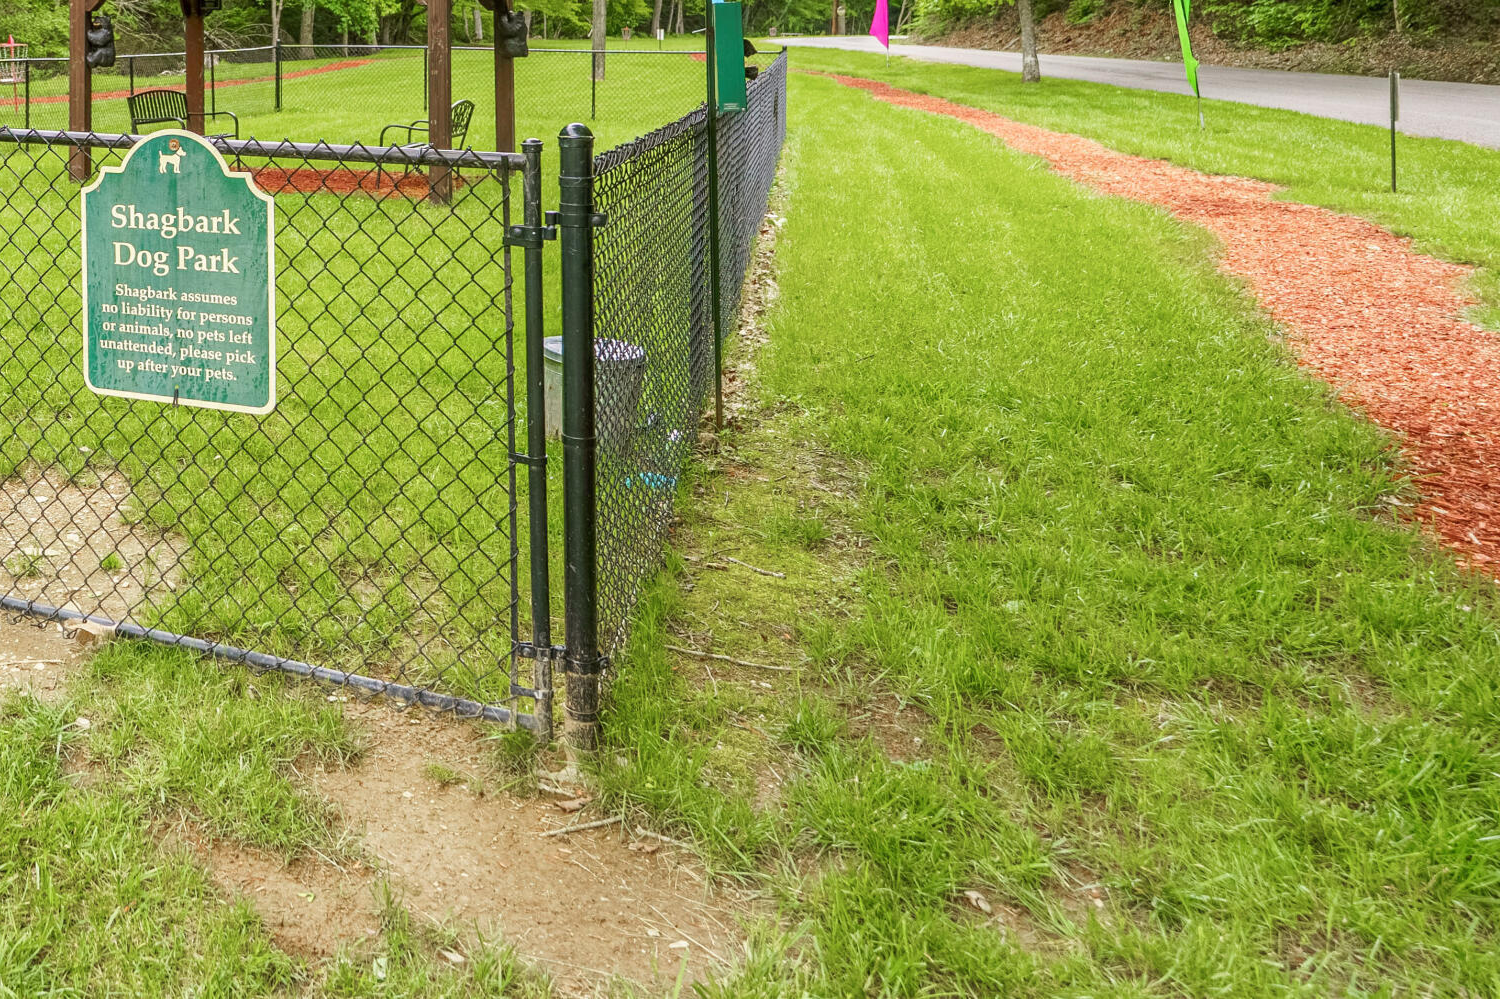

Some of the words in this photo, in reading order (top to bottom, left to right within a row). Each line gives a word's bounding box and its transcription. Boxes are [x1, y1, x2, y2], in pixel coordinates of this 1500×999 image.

[111, 204, 241, 239] Shagbark
[112, 241, 170, 277] Dog
[176, 246, 240, 274] Park
[115, 283, 177, 301] Shagbark
[180, 291, 238, 306] assumes
[101, 303, 118, 313] no
[121, 301, 173, 321] liability
[176, 306, 197, 321] for
[199, 312, 253, 326] persons
[102, 322, 117, 331] or
[118, 321, 173, 339] animals,
[176, 328, 194, 339] no
[197, 330, 225, 343] pets
[228, 330, 253, 345] left
[99, 339, 176, 358] unattended,
[179, 345, 222, 361] please
[225, 349, 256, 365] pick
[117, 359, 135, 373] up
[137, 359, 168, 373] after
[171, 364, 202, 378] your
[205, 368, 237, 382] pets.
